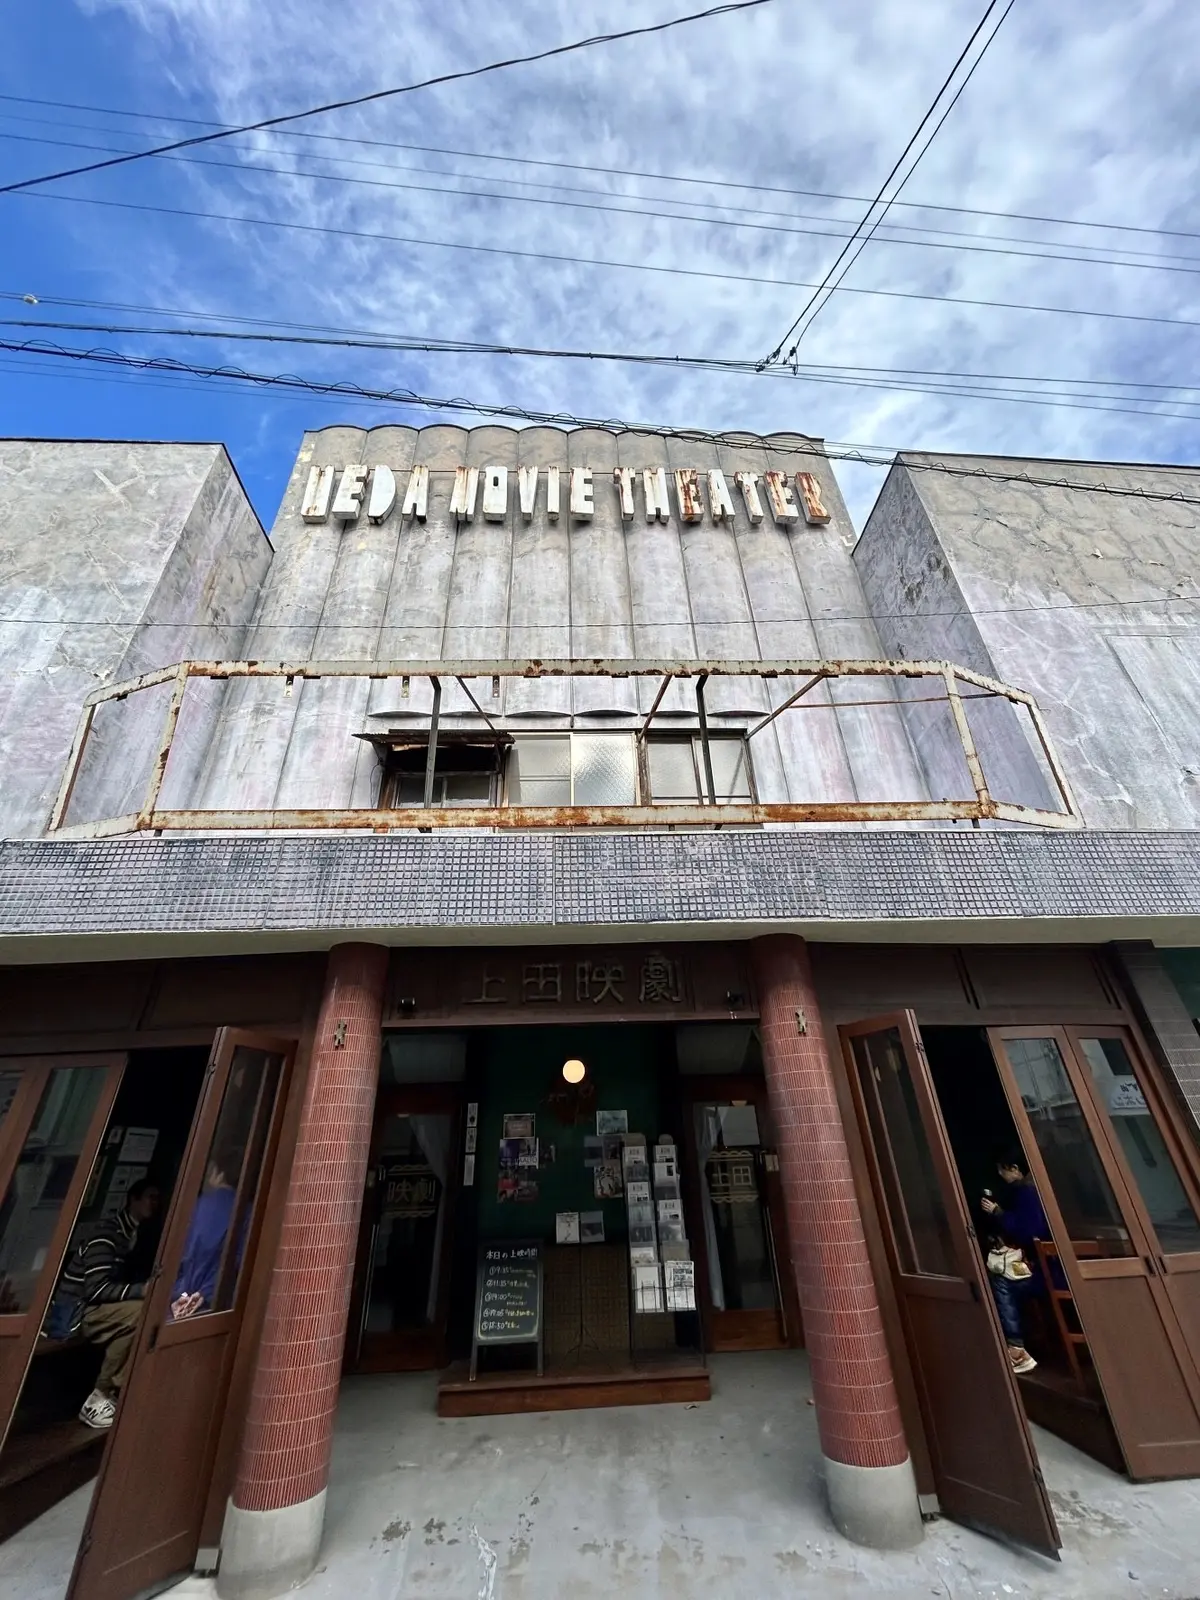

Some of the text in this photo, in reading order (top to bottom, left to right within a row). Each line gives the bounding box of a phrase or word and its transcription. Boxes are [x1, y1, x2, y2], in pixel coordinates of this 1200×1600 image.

[300, 464, 831, 525] UEDA MOVIE THEATER
[462, 949, 683, 1005] 上田映劇
